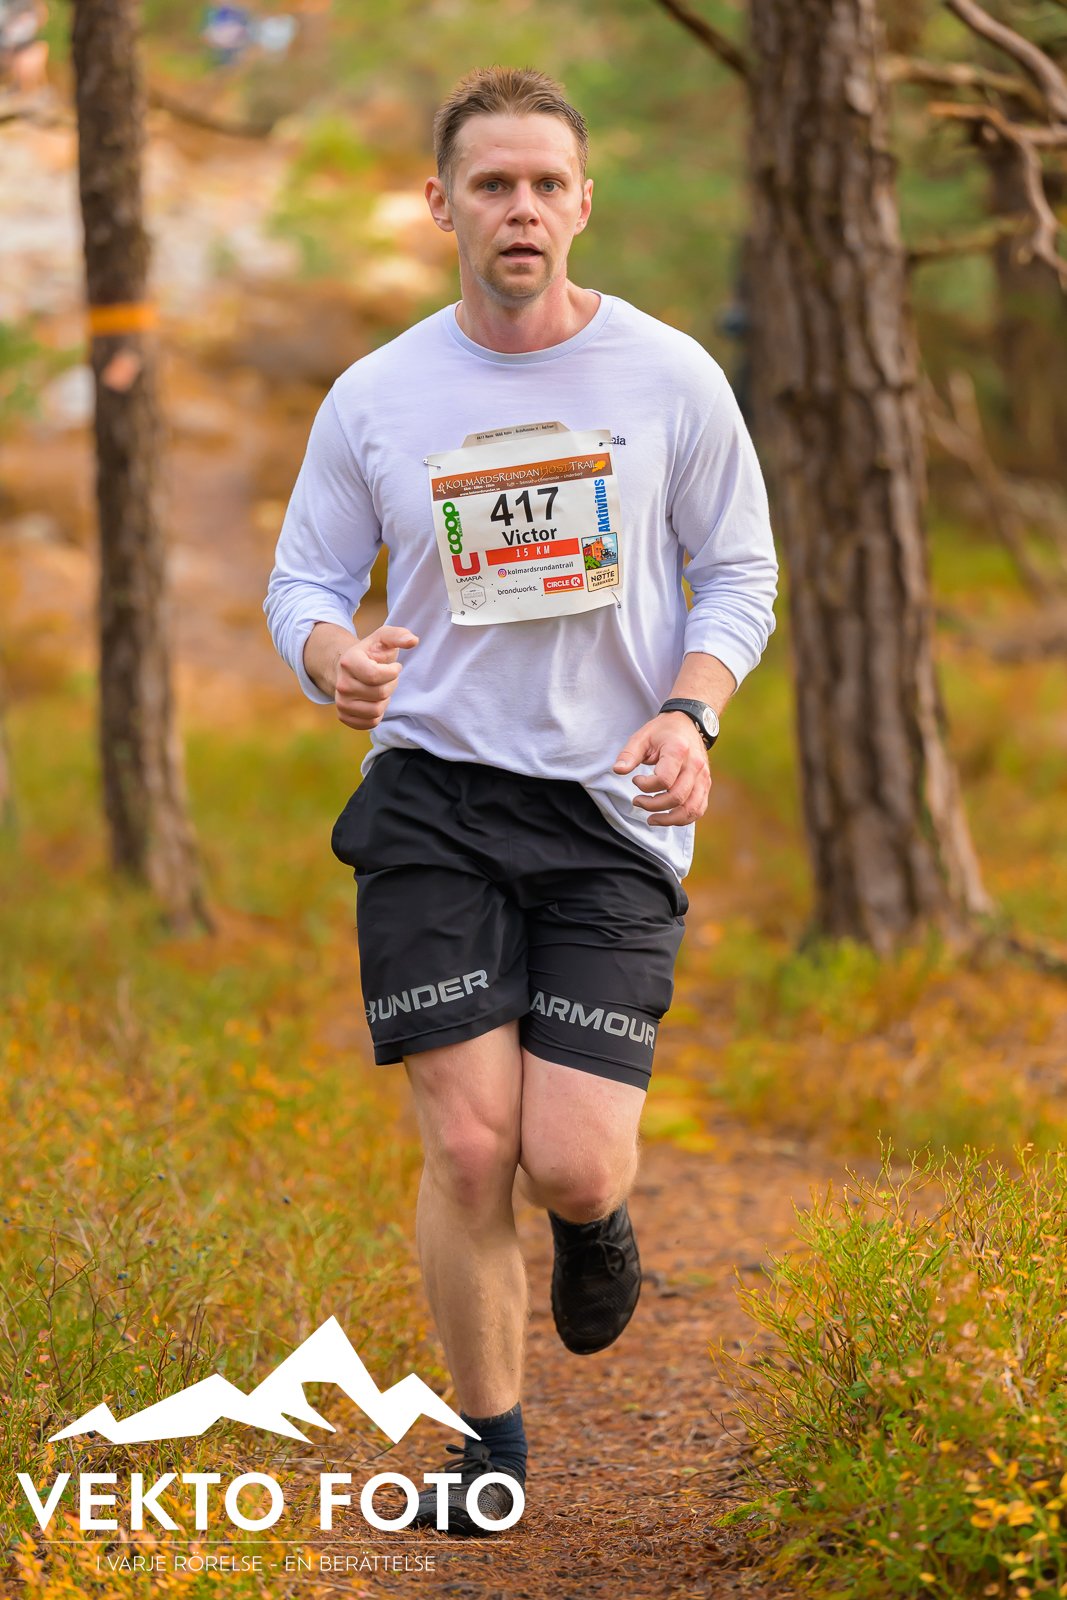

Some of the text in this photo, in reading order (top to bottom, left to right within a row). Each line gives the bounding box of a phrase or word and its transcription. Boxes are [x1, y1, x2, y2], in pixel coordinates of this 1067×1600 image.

[490, 486, 559, 526] 417
[594, 478, 611, 532] Aktivitus
[442, 501, 463, 555] coop
[502, 527, 558, 546] Victor
[516, 545, 550, 558] 15 KM
[455, 575, 483, 583] UMARA
[507, 561, 574, 576] kolmardsrundantrail
[546, 579, 570, 588] CIRCLE
[378, 968, 490, 1020] UNDER
[530, 991, 656, 1049] ARMOUR
